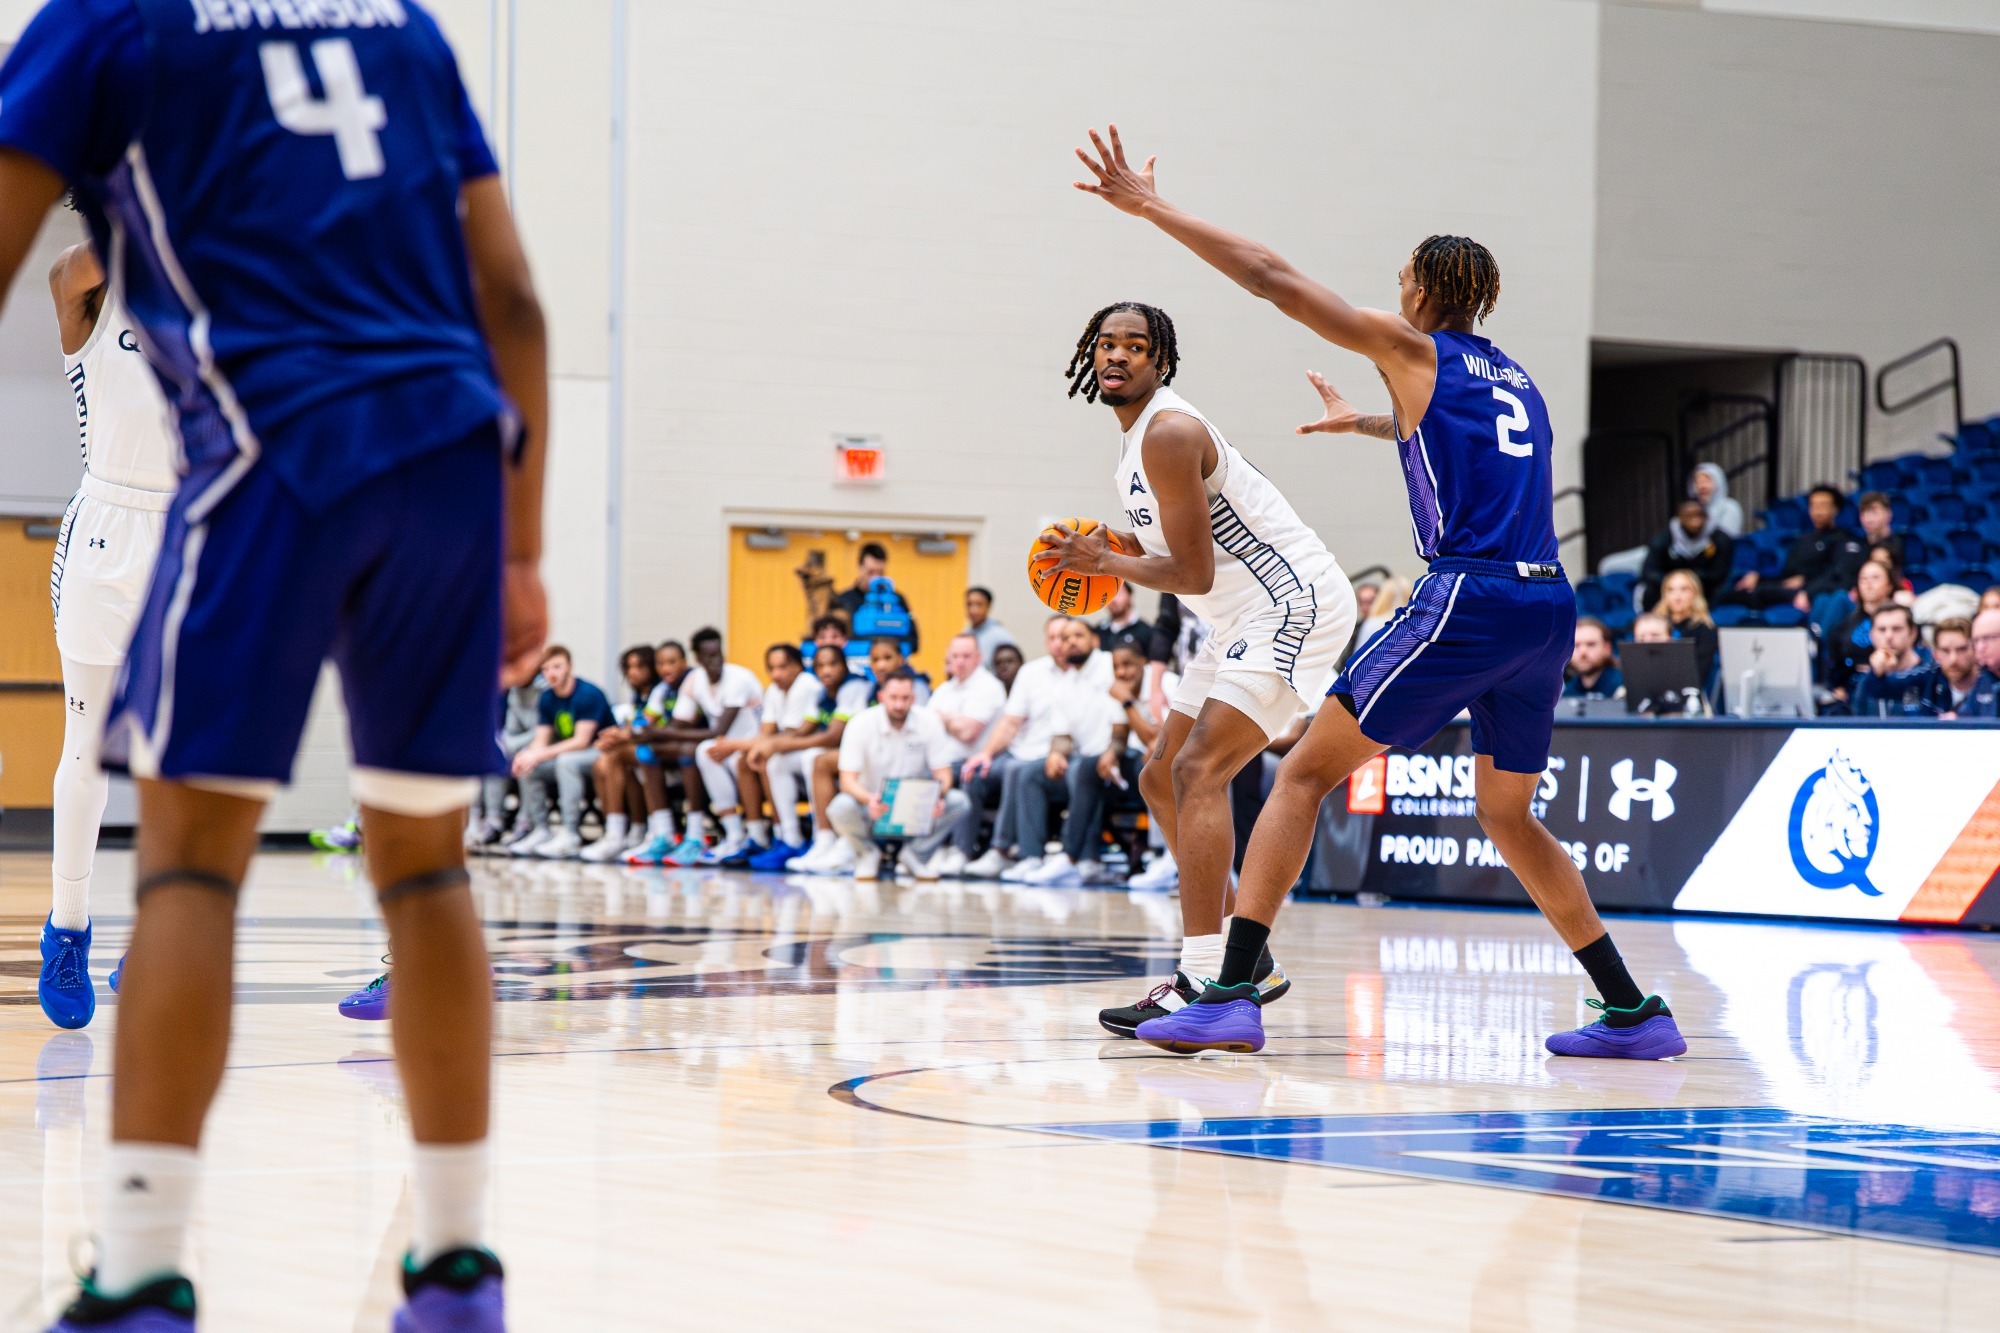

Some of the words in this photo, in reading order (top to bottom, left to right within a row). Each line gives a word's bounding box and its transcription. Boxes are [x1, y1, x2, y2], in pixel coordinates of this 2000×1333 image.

[258, 37, 389, 181] 4
[1492, 386, 1533, 457] 2
[1391, 797, 1477, 817] COLLEGIAT
[1379, 834, 1460, 865] PROUD
[1594, 842, 1631, 873] OF
